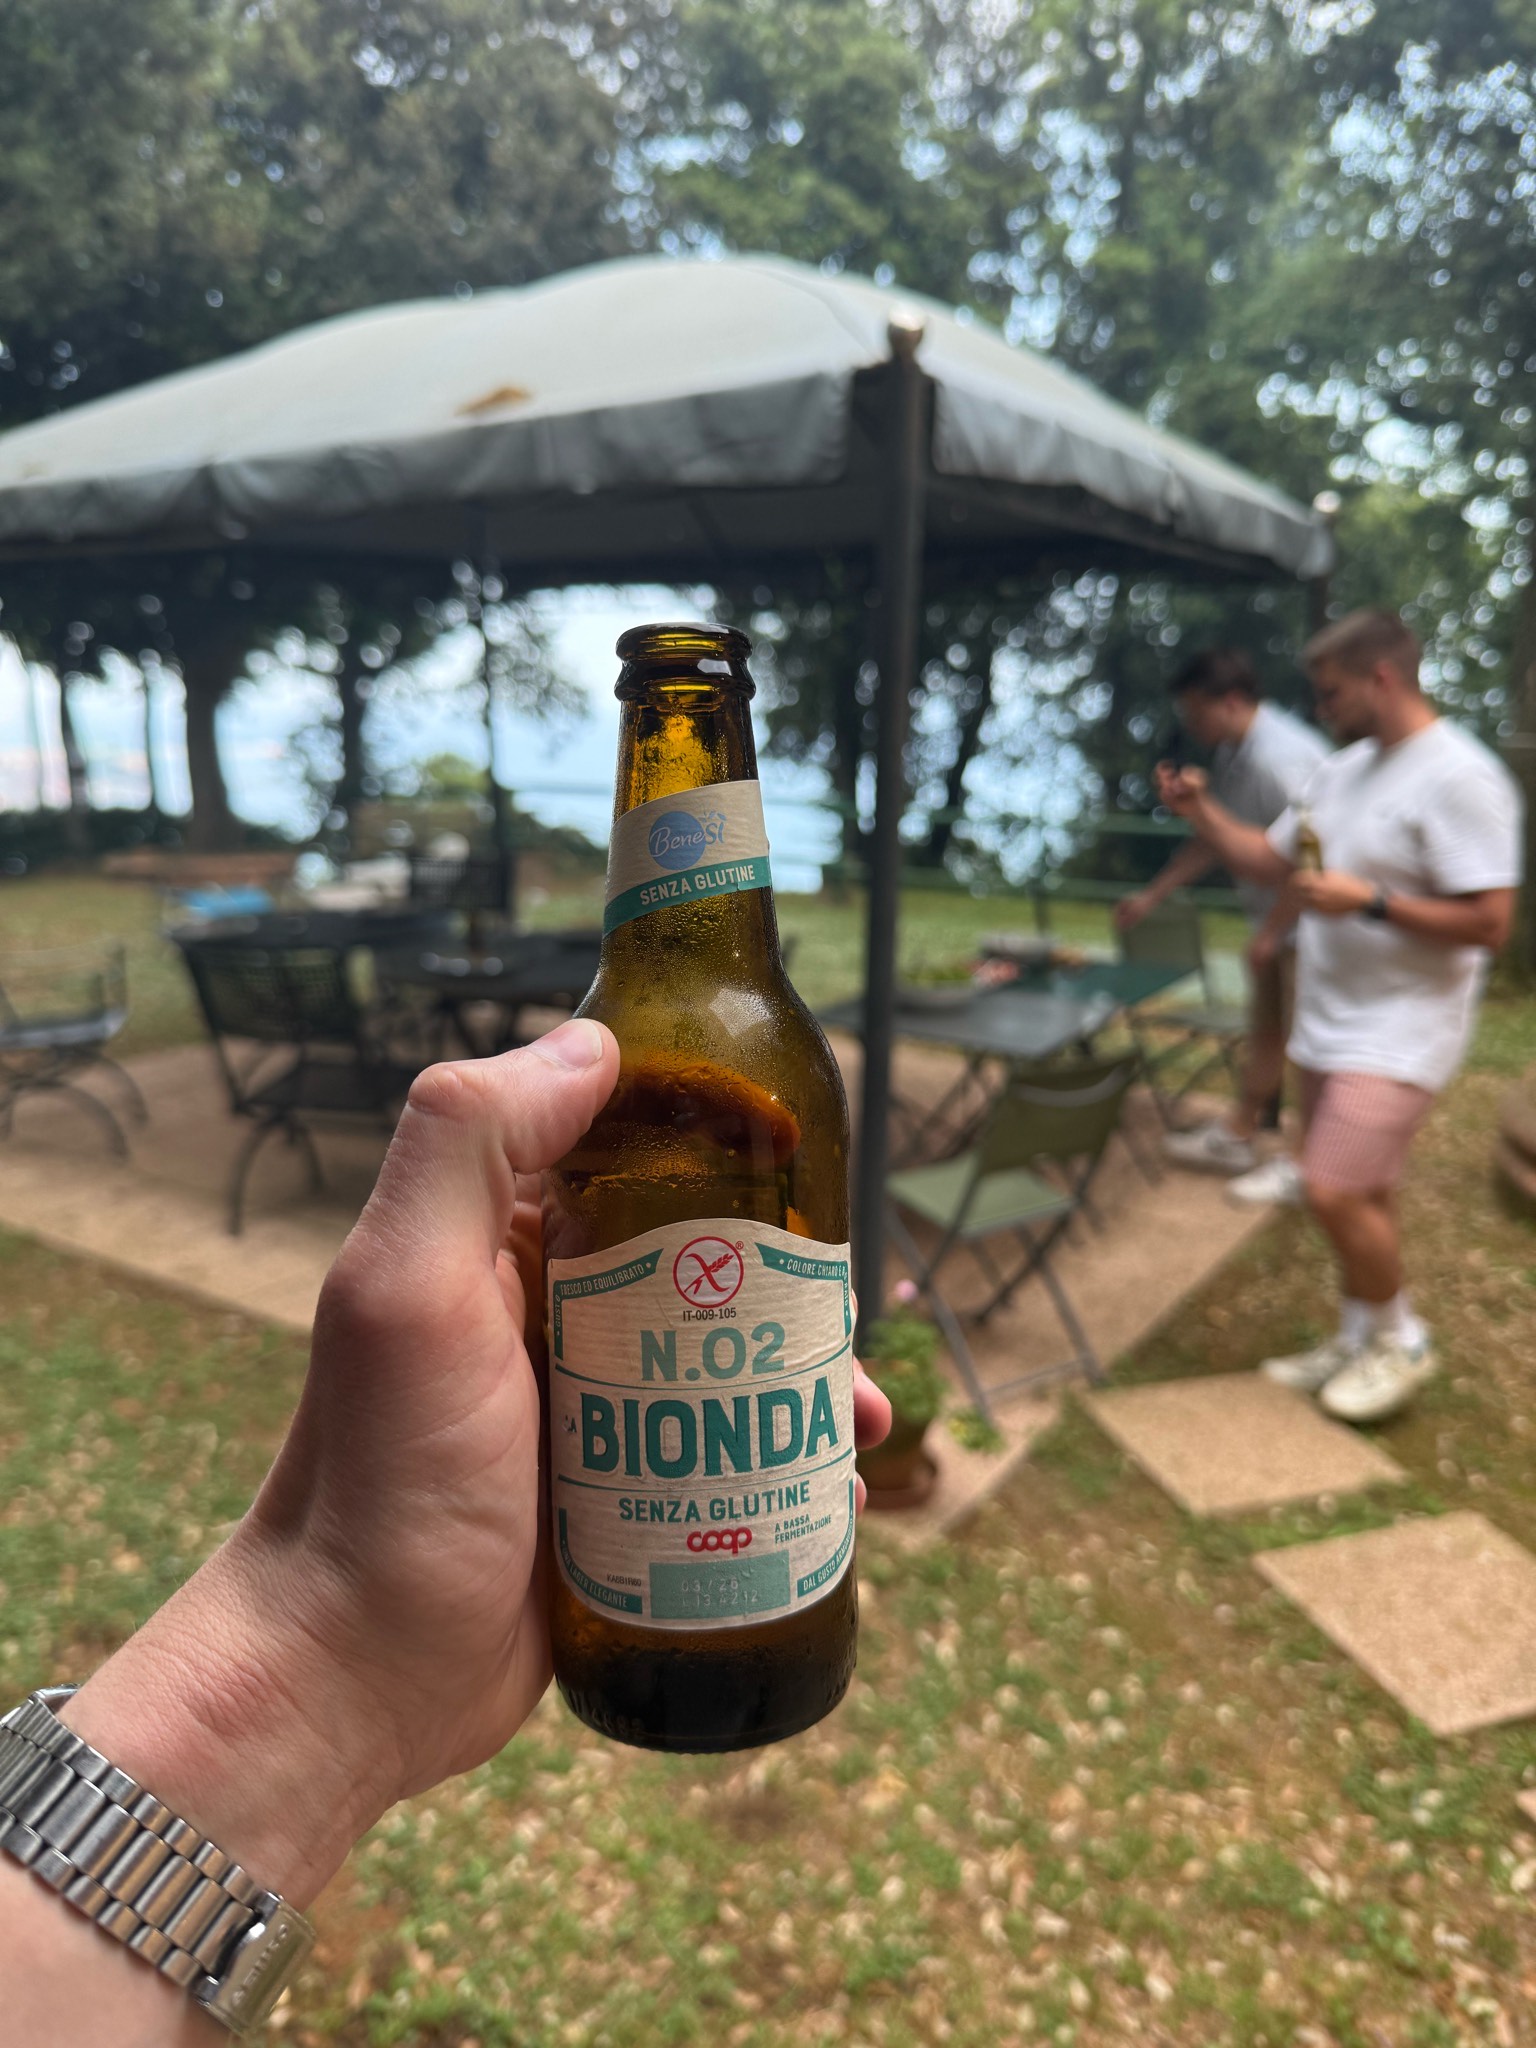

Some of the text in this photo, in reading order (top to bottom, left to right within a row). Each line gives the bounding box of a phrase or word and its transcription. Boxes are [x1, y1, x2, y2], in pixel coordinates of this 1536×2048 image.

[639, 865, 756, 906] SENZA GLUTINE
[583, 1280, 593, 1293] ED
[593, 1263, 645, 1290] EQUILIBRATO
[786, 1258, 816, 1275] COLORE
[817, 1264, 838, 1277] CHIARO
[682, 1307, 737, 1321] IT-009-105
[580, 1375, 839, 1479] BIONDA
[619, 1480, 811, 1523] SENZA GLUTINE
[774, 1514, 832, 1544] FERMENTAZIONE
[775, 1514, 811, 1533] A BASSA
[686, 1526, 753, 1557] coop
[803, 1577, 816, 1591] DAL
[817, 1561, 836, 1583] GUSTO
[589, 1582, 628, 1608] ELEGANTE
